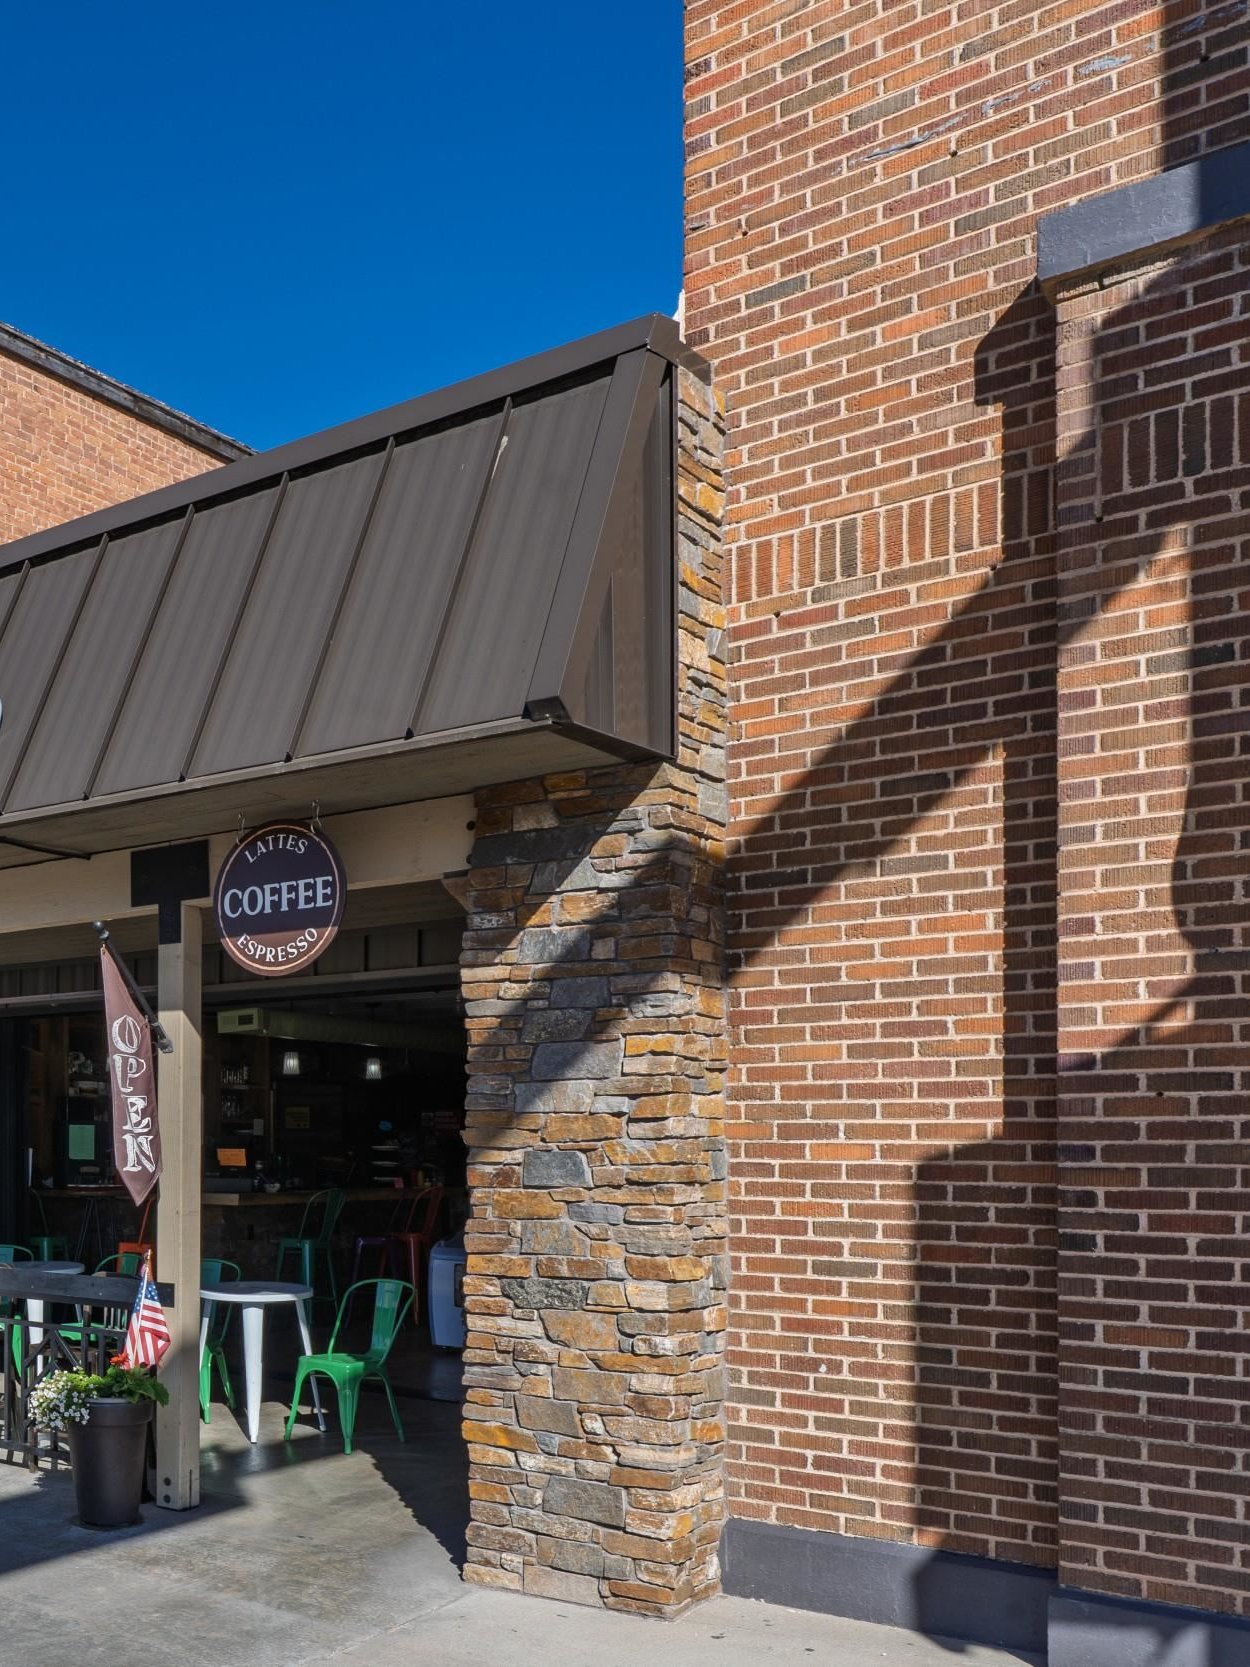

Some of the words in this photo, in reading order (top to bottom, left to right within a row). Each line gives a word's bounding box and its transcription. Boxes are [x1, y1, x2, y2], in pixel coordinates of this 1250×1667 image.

[244, 833, 309, 864] LATTES
[223, 875, 333, 919] COFFEE
[237, 927, 318, 963] ESPRESSO
[111, 1014, 156, 1172] OPEN
